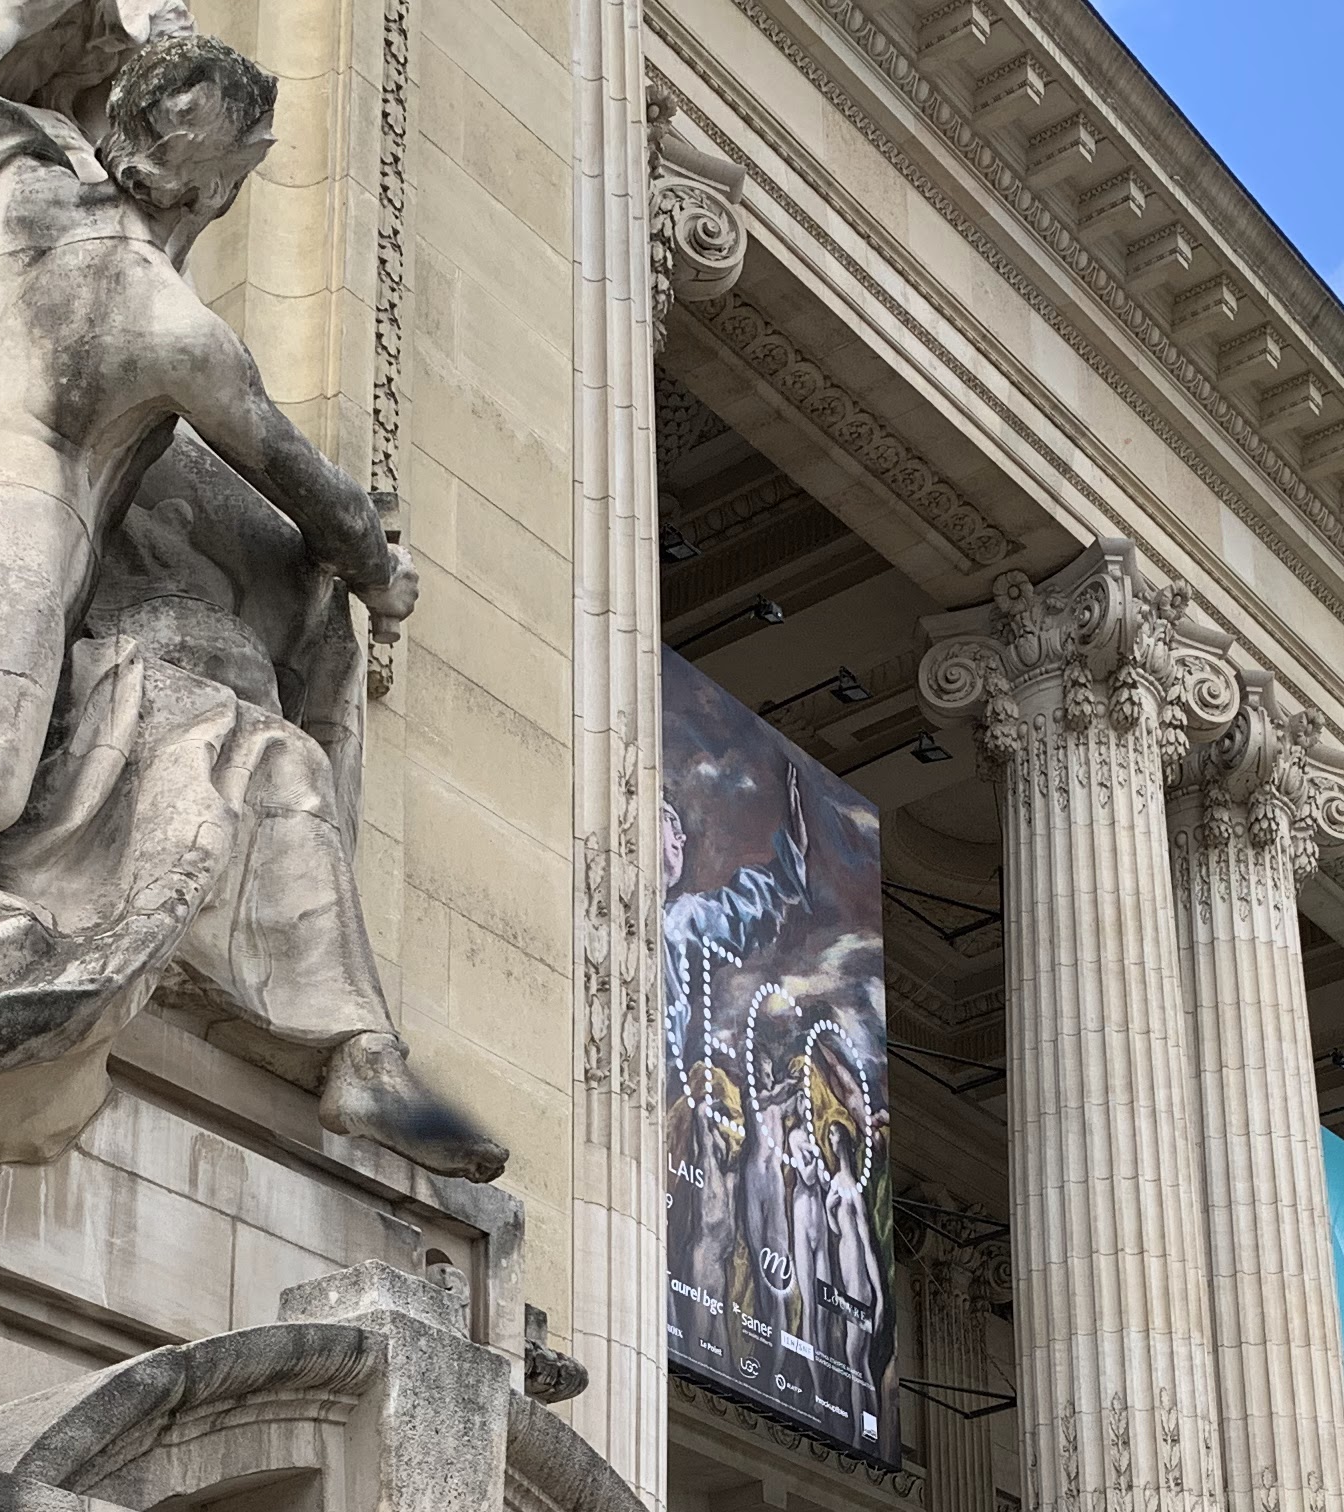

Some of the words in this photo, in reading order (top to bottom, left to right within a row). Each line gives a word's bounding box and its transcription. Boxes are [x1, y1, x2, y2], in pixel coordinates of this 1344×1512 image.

[671, 1279, 701, 1303] aurel
[702, 1289, 724, 1315] bgc
[822, 1286, 867, 1323] LOUVRE
[740, 1357, 759, 1376] UGC
